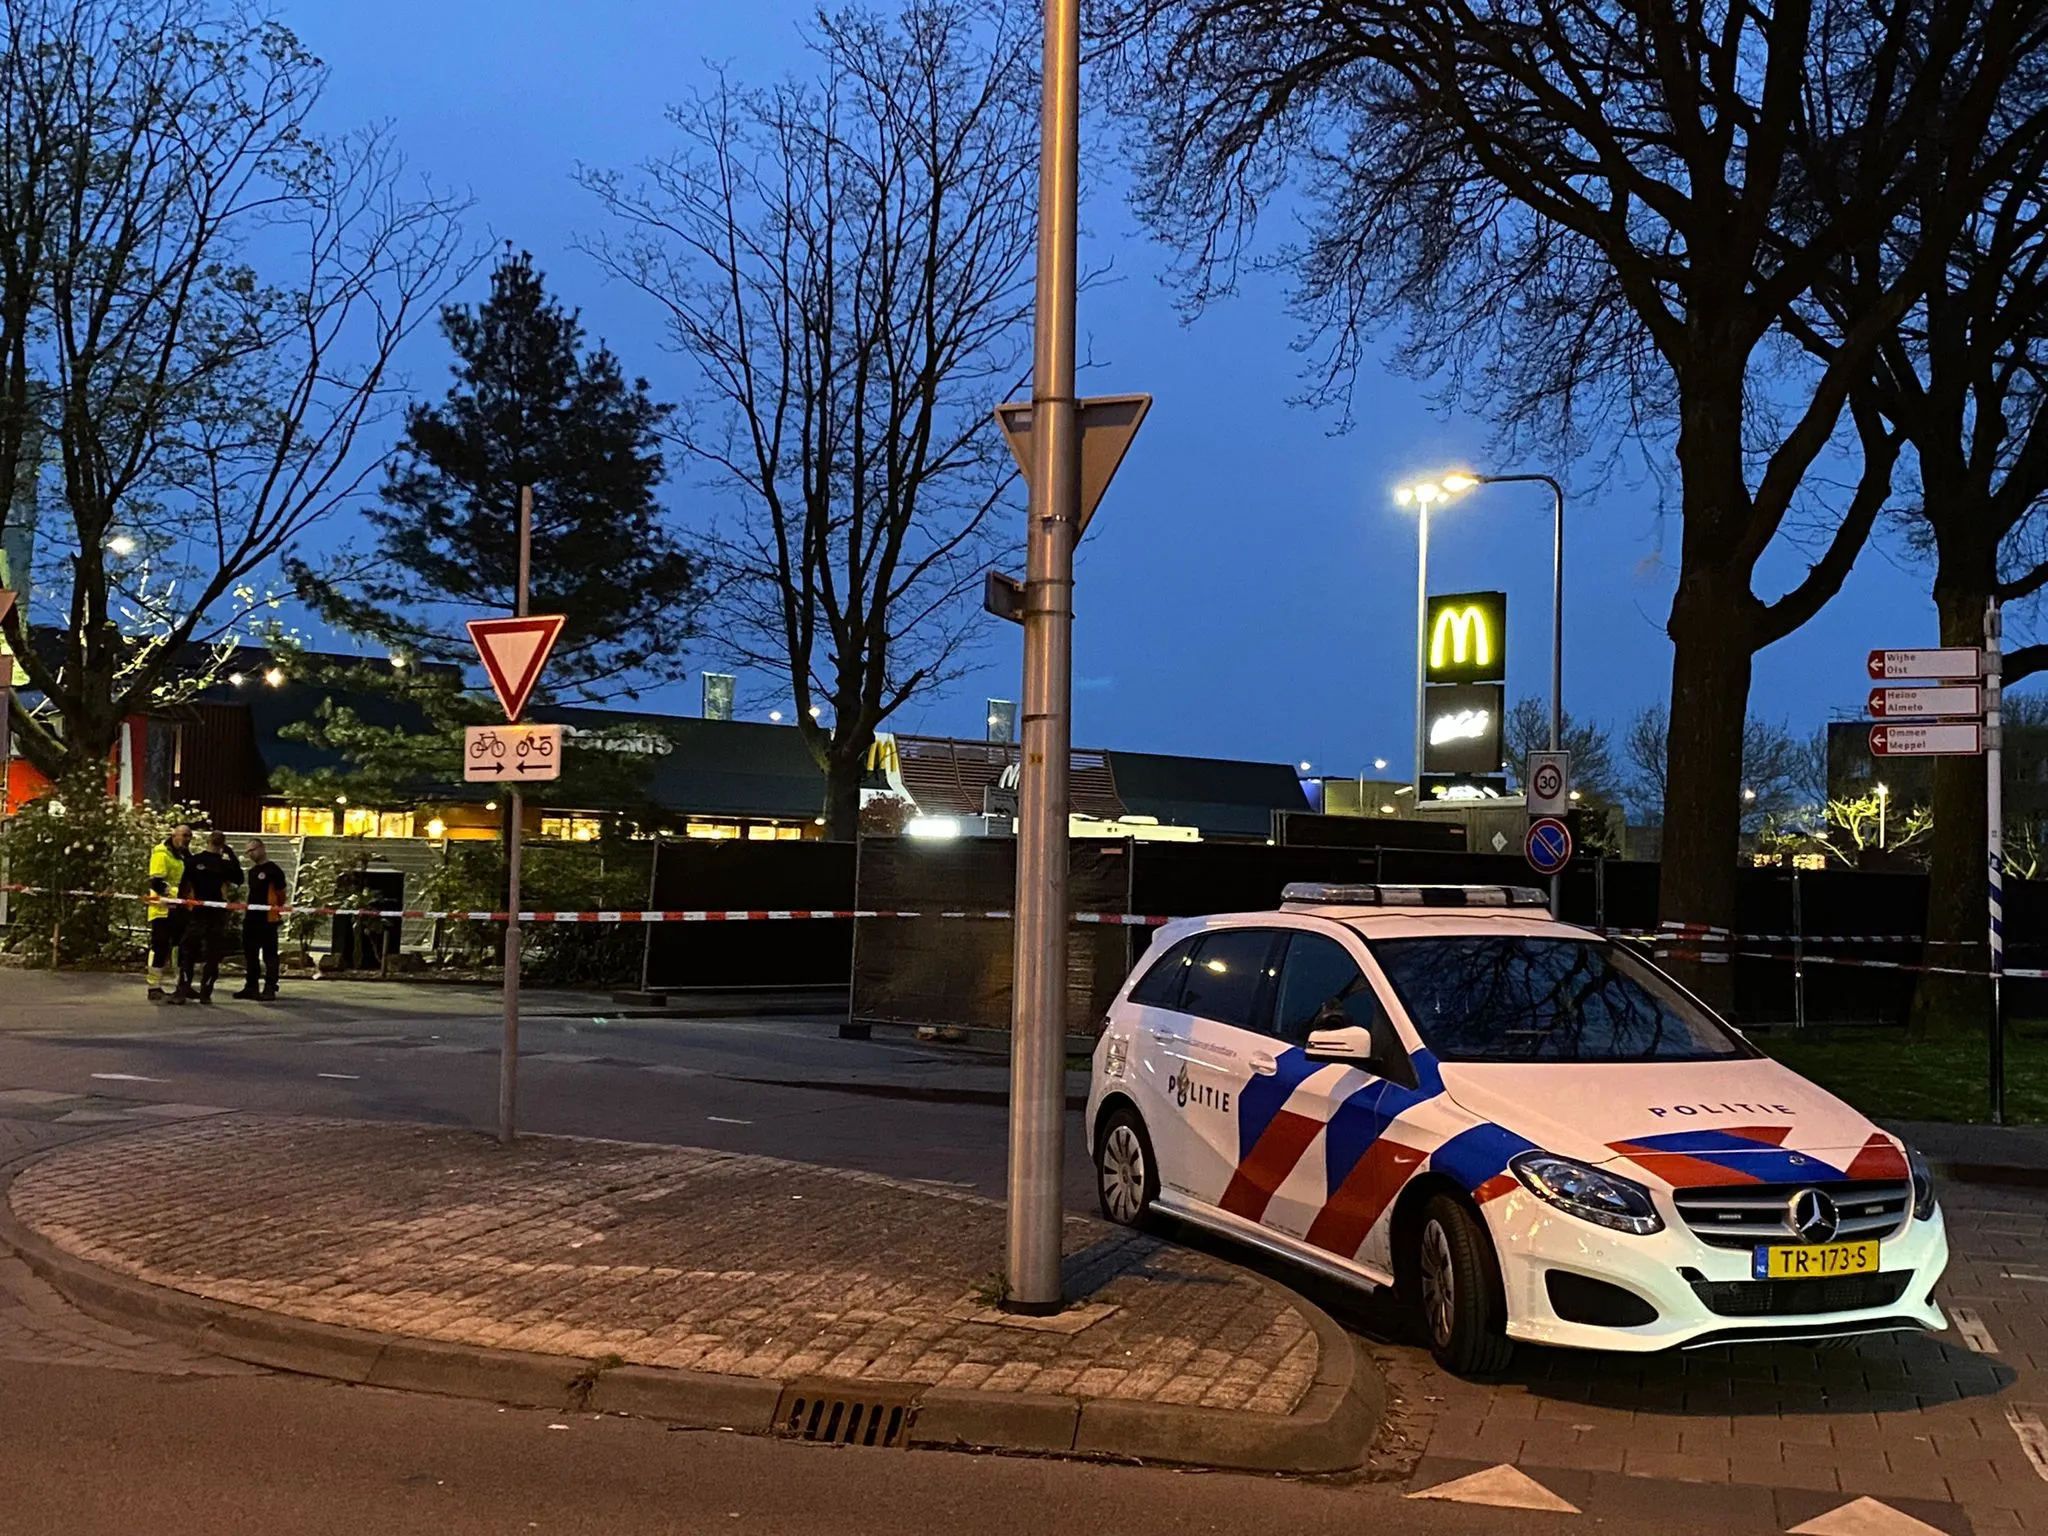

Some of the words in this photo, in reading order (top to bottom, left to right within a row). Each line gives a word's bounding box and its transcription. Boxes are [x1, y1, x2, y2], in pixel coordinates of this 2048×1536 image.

[1886, 654, 1916, 663] Wijhe
[1887, 665, 1908, 674] Olst
[1887, 690, 1917, 699] Heino
[1887, 704, 1924, 712] Almelo
[1889, 728, 1927, 737] Ommen
[1889, 741, 1926, 750] Meppel
[1539, 776, 1557, 789] 30
[1168, 1070, 1230, 1112] POLITIE
[1648, 1102, 1796, 1117] POLITIE
[1780, 1245, 1867, 1273] TR-173-S
